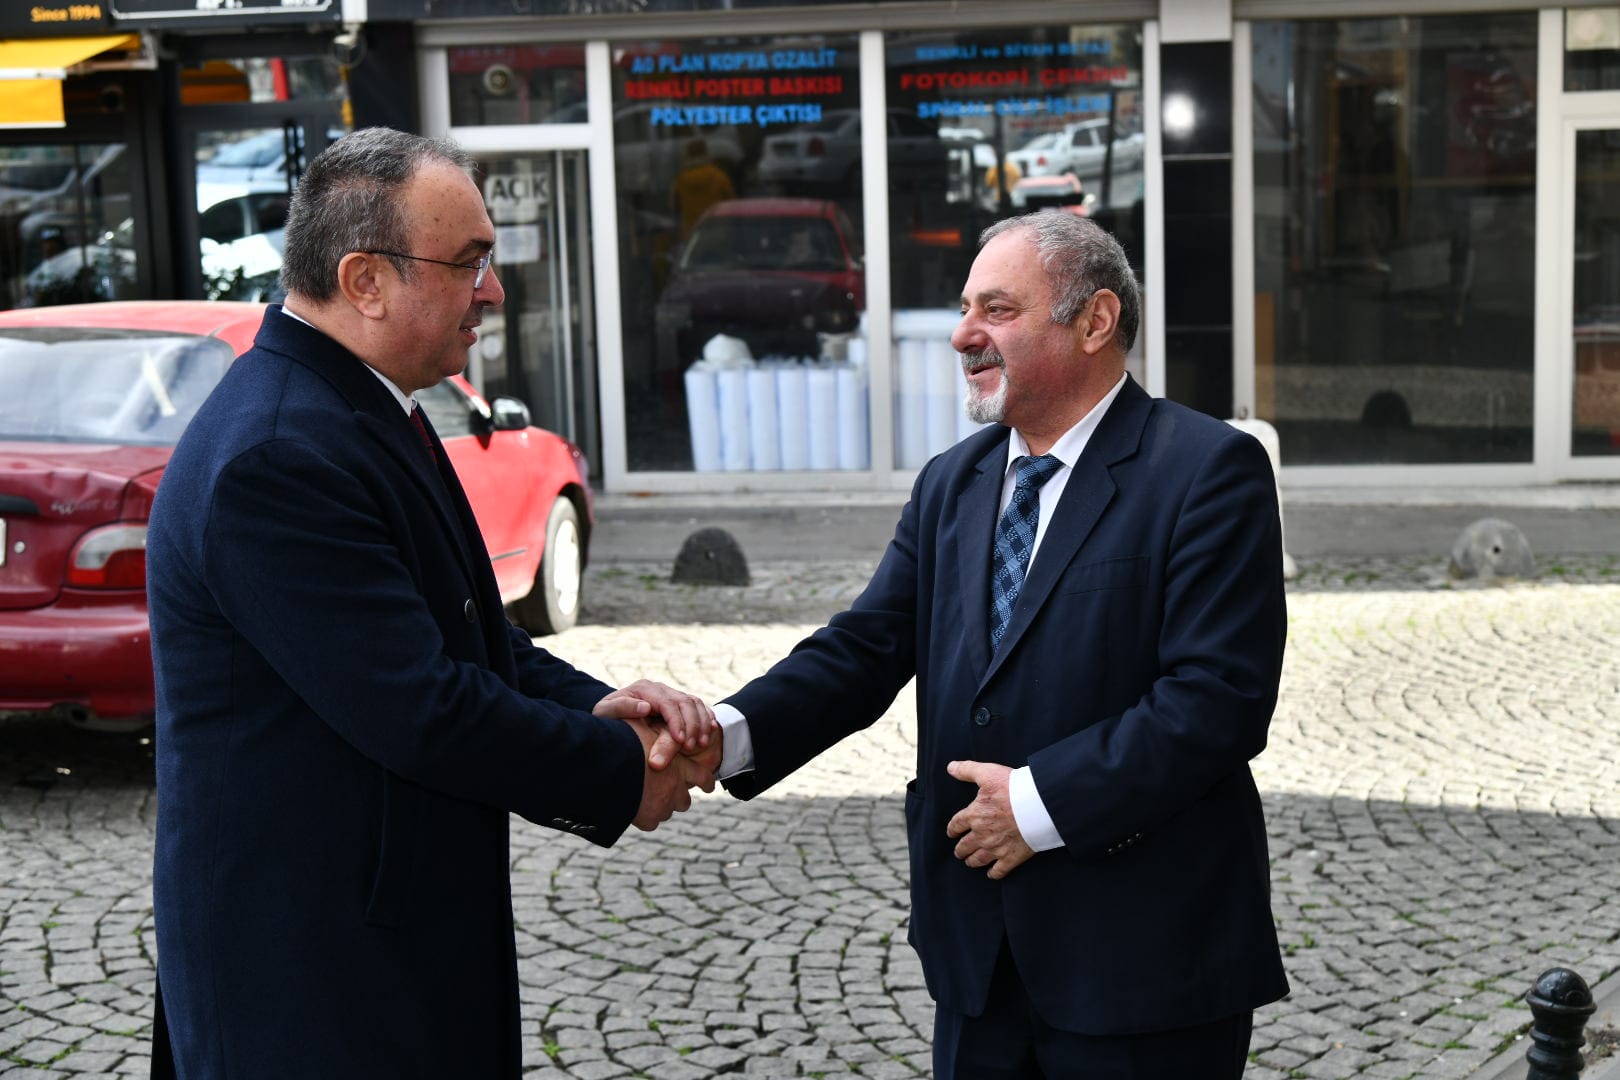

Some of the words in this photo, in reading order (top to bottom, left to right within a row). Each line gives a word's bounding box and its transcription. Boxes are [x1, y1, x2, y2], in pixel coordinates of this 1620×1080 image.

[31, 6, 68, 23] Since
[69, 4, 102, 21] 1994
[659, 54, 704, 72] PLAN
[982, 48, 999, 58] ve
[696, 78, 764, 96] POSTER
[770, 76, 841, 95] BASKISI
[901, 67, 1028, 90] FOTOKOPİ
[652, 105, 751, 126] POLYESTER
[755, 104, 821, 127] ÇIKTISI
[489, 177, 549, 206] AÇIK
